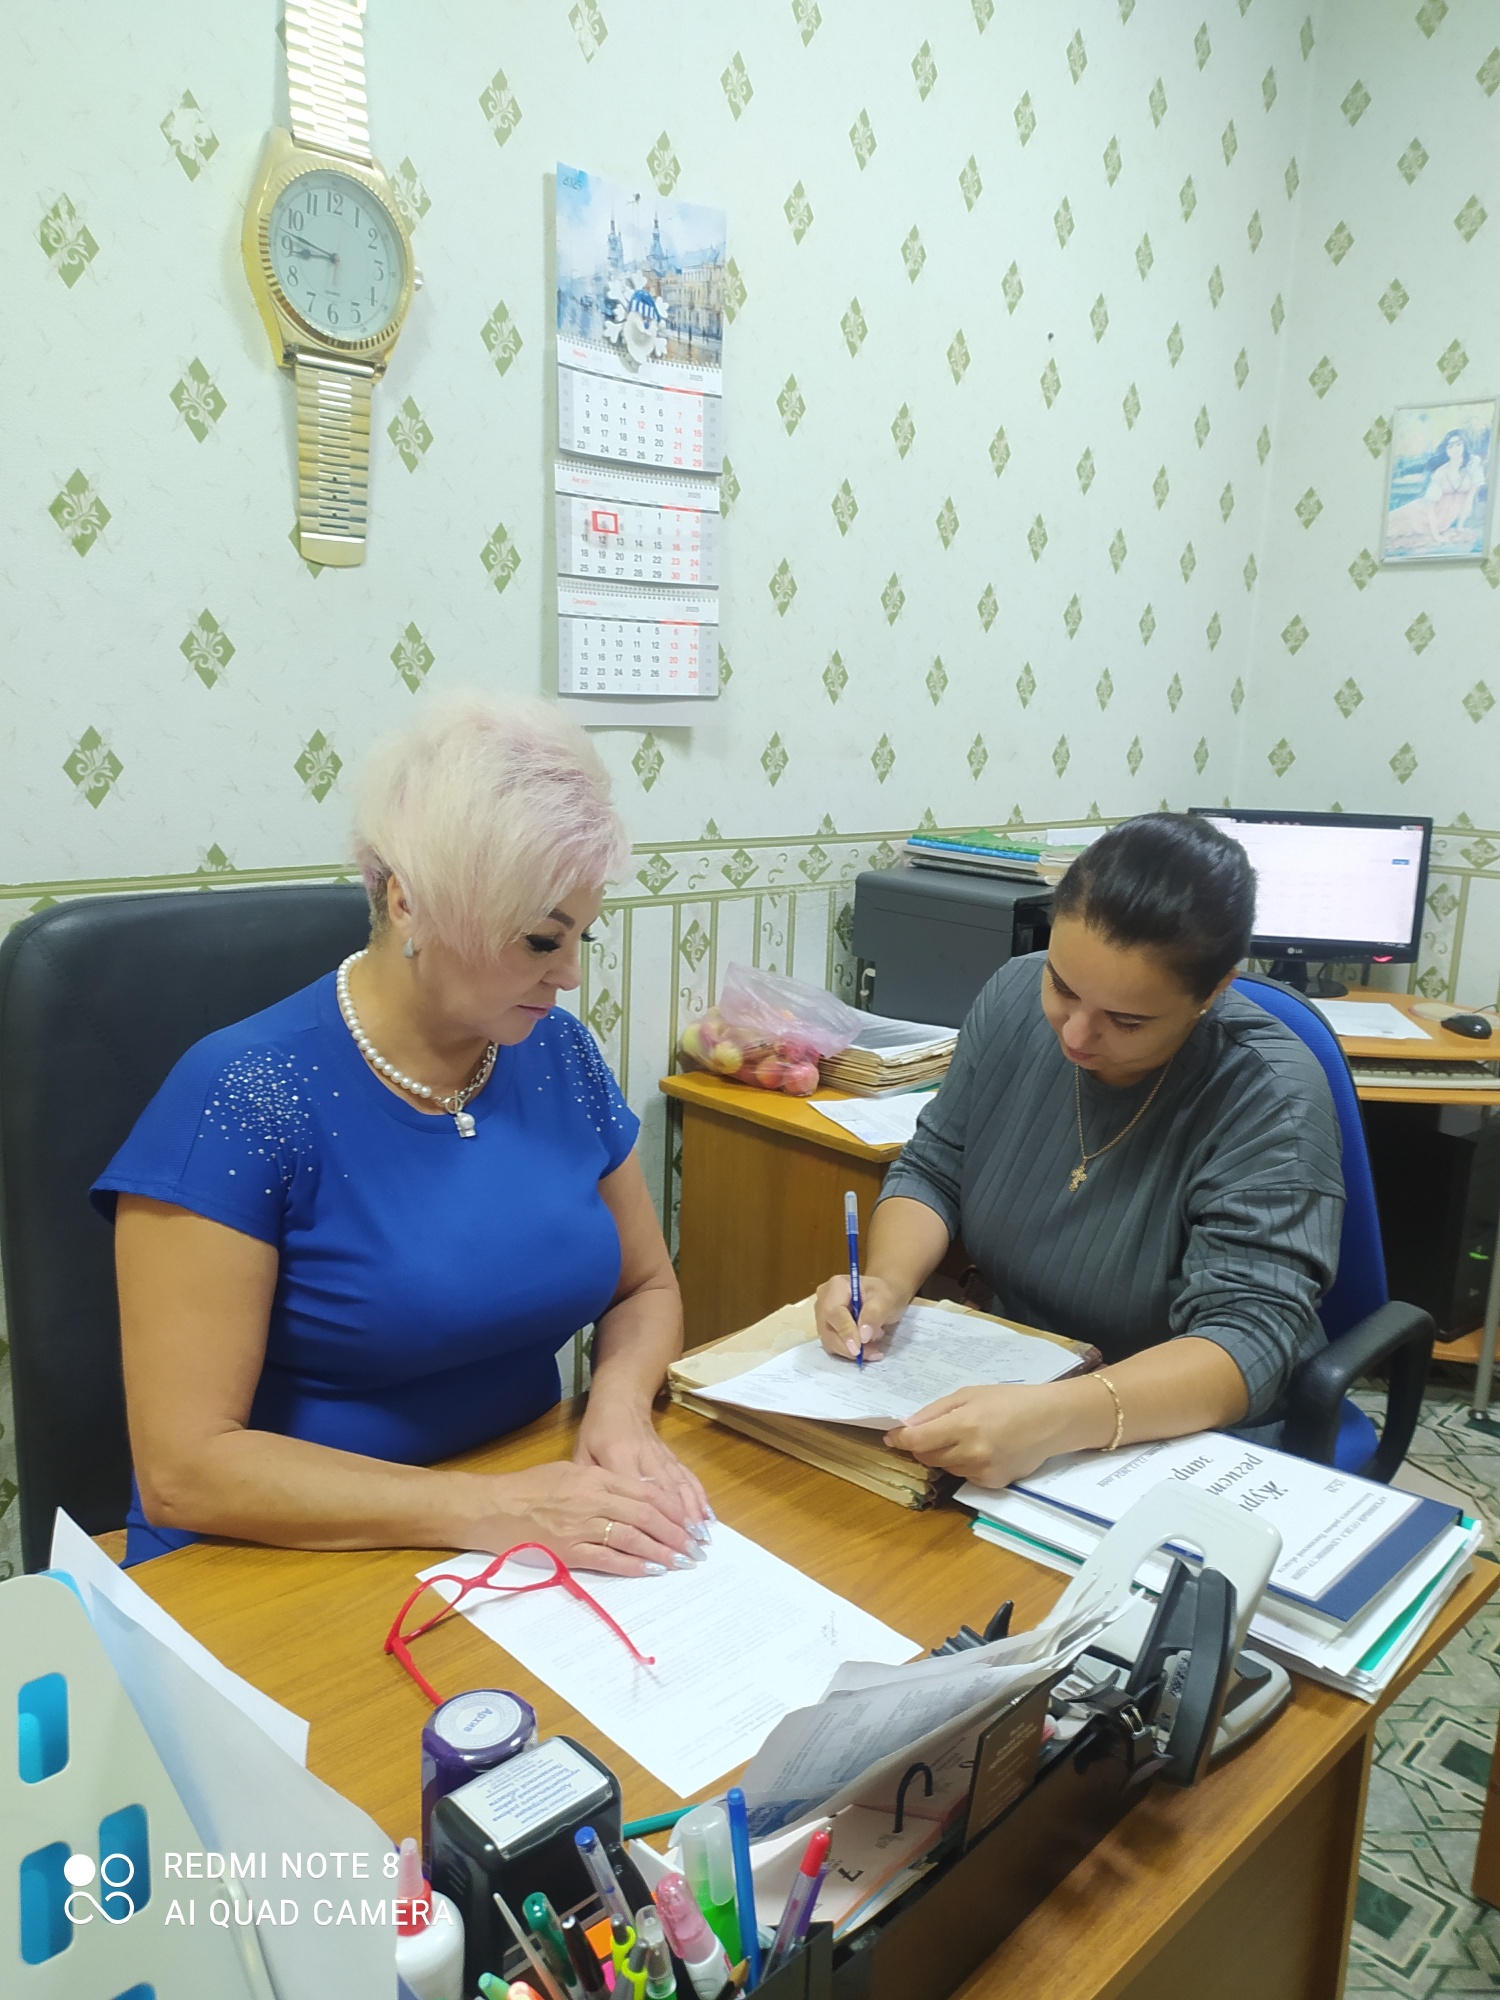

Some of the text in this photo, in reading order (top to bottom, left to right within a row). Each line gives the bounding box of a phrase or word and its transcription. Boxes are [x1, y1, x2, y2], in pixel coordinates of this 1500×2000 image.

[306, 192, 318, 216] 11
[327, 191, 344, 216] 12
[288, 208, 304, 232] 10
[354, 207, 360, 229] 1
[281, 235, 293, 258] 9
[368, 228, 379, 250] 2
[286, 265, 299, 287] 8
[373, 259, 385, 281] 3
[306, 291, 317, 313] 7
[364, 286, 378, 307] 4
[327, 302, 340, 325] 6
[350, 301, 361, 324] 5
[585, 393, 591, 403] 2
[603, 398, 608, 407] 3
[621, 402, 627, 410] 4
[640, 405, 645, 414] 5
[658, 408, 664, 417] 6
[585, 410, 590, 419] 9
[600, 413, 609, 423] 10
[619, 417, 627, 426] 11
[655, 423, 664, 432] 13
[582, 425, 591, 434] 16
[601, 429, 609, 438] 17
[619, 432, 628, 441] 18
[637, 435, 646, 445] 19
[654, 438, 664, 448] 20
[576, 440, 586, 450] 23
[600, 444, 609, 453] 24
[618, 447, 628, 457] 25
[636, 450, 646, 460] 26
[654, 453, 664, 462] 27
[657, 511, 661, 521] 1
[675, 513, 680, 523] 2
[581, 532, 588, 543] 11
[598, 534, 607, 544] 12
[616, 537, 625, 546] 13
[634, 539, 643, 548] 14
[653, 541, 662, 550] 15
[580, 549, 589, 558] 18
[598, 550, 607, 559] 19
[615, 552, 624, 561] 20
[633, 554, 643, 563] 21
[652, 555, 662, 565] 22
[580, 564, 589, 573] 25
[597, 565, 607, 574] 26
[615, 567, 625, 576] 27
[633, 568, 643, 578] 28
[652, 570, 662, 579] 29
[690, 573, 699, 582] 31
[584, 623, 588, 631] 1
[600, 624, 606, 633] 2
[618, 625, 623, 634] 3
[636, 626, 641, 634] 4
[654, 627, 660, 636] 5
[583, 637, 589, 646] 8
[600, 638, 606, 647] 9
[615, 639, 623, 648] 10
[633, 640, 640, 649] 11
[651, 641, 660, 650] 12
[580, 652, 588, 661] 15
[598, 653, 606, 661] 16
[615, 653, 623, 662] 17
[633, 654, 641, 663] 18
[651, 655, 660, 664] 19
[579, 666, 589, 676] 22
[596, 667, 606, 676] 23
[614, 668, 623, 677] 24
[632, 668, 641, 678] 25
[650, 669, 660, 678] 26
[580, 681, 589, 690] 29
[596, 682, 606, 691] 30
[1167, 1454, 1214, 1481] запр
[463, 1707, 493, 1733] Архив
